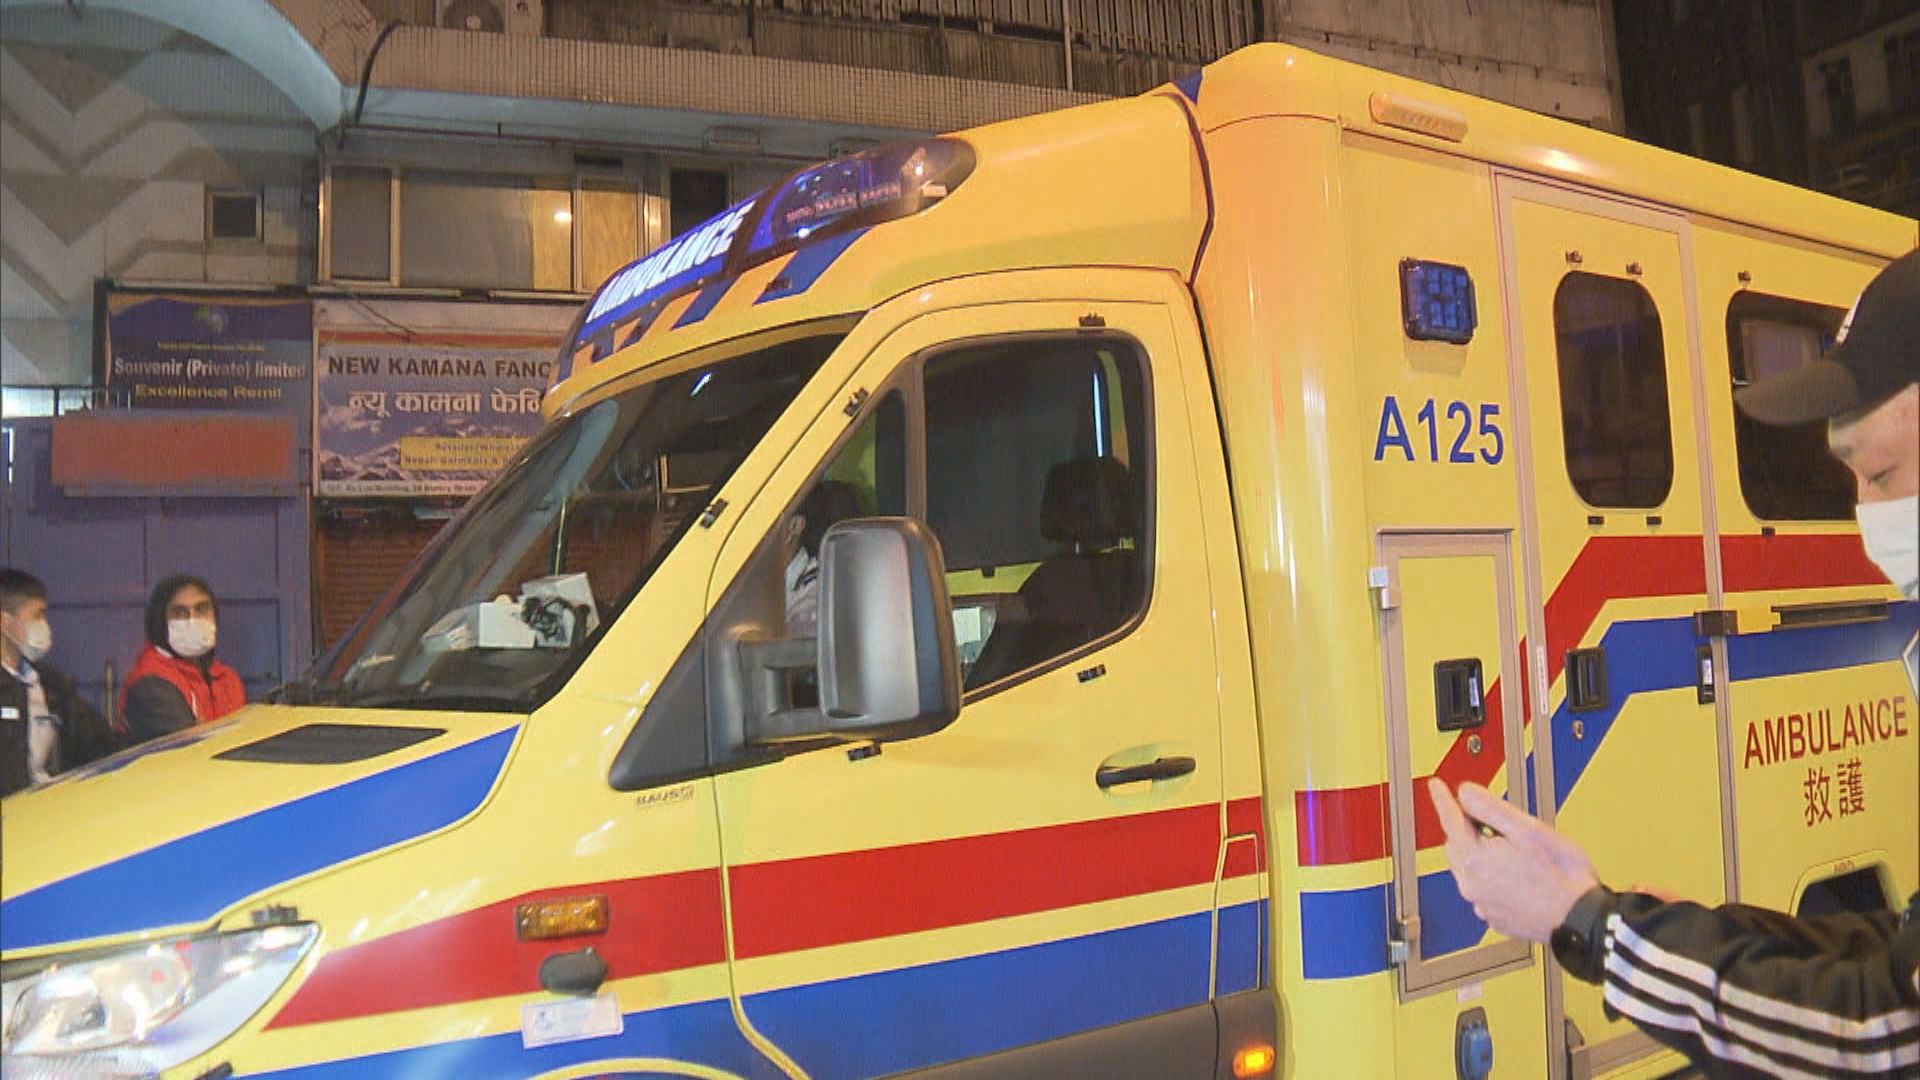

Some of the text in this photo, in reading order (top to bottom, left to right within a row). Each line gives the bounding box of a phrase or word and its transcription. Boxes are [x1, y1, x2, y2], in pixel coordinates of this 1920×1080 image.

[114, 357, 184, 376] Souvenir
[186, 357, 250, 379] (Private)
[328, 356, 380, 375] NEW
[388, 357, 486, 377] KAMANA
[135, 383, 228, 398] Excellence
[395, 391, 480, 414] कामना
[1374, 396, 1504, 465] A125
[1744, 695, 1909, 770] AMBULANCE
[1803, 757, 1866, 828] 救護
